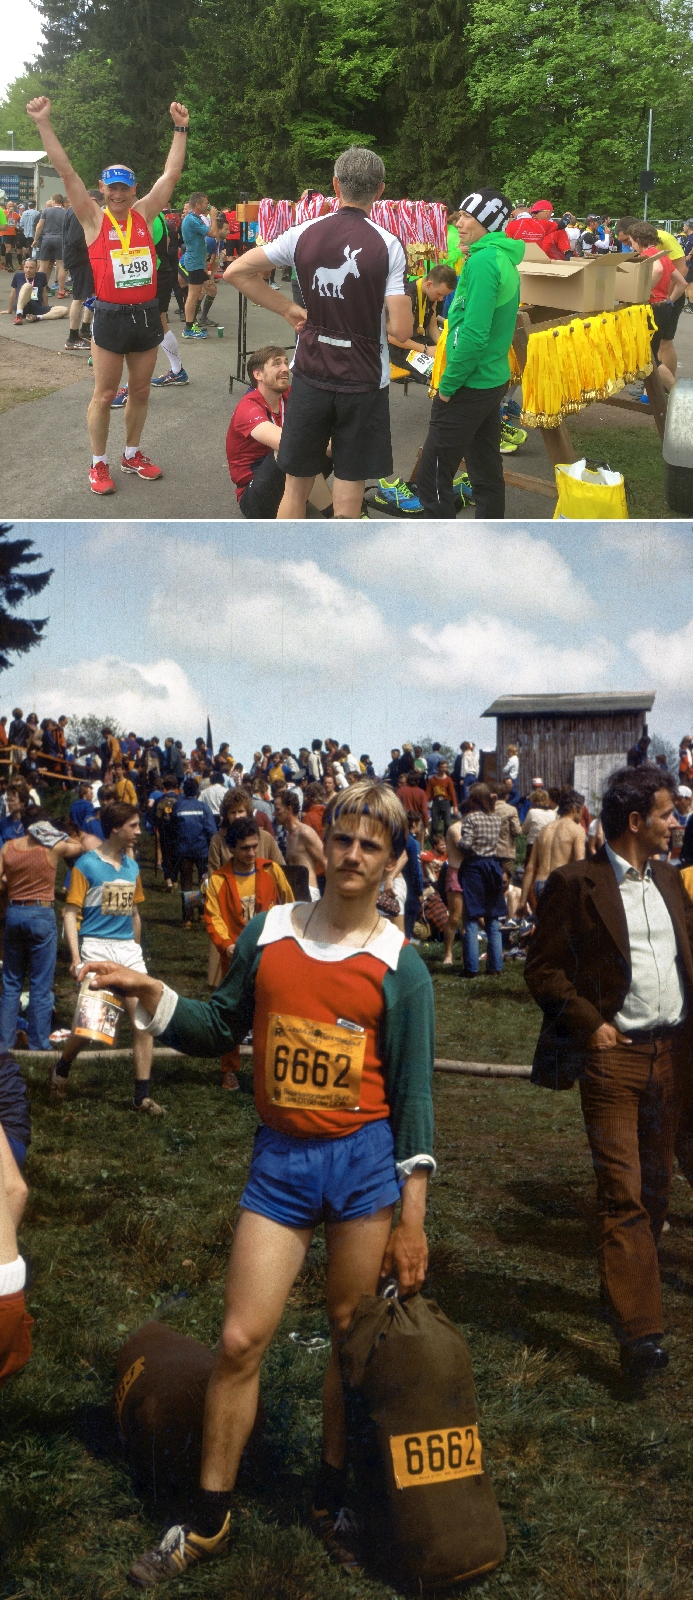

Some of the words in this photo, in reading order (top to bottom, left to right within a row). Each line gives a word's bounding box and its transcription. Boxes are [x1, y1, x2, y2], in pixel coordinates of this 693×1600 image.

[119, 260, 149, 275] 1298
[273, 1044, 352, 1089] 6662
[404, 1427, 476, 1475] 6662
